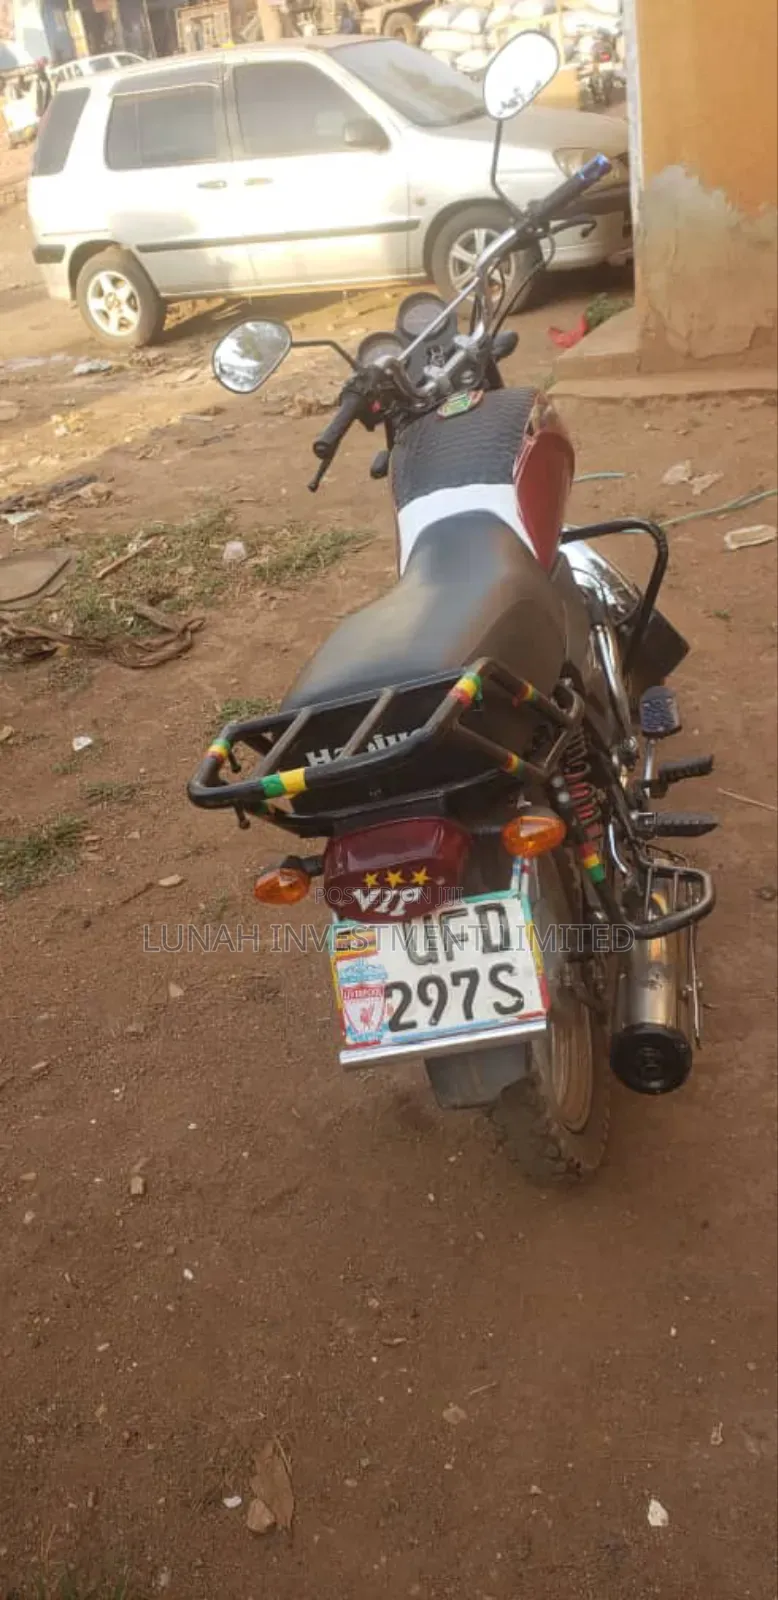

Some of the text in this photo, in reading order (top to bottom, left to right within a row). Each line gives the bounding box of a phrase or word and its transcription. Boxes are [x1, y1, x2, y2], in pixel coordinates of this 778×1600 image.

[352, 886, 423, 916] VIP
[402, 902, 511, 966] UFD
[384, 963, 525, 1032] 297S
